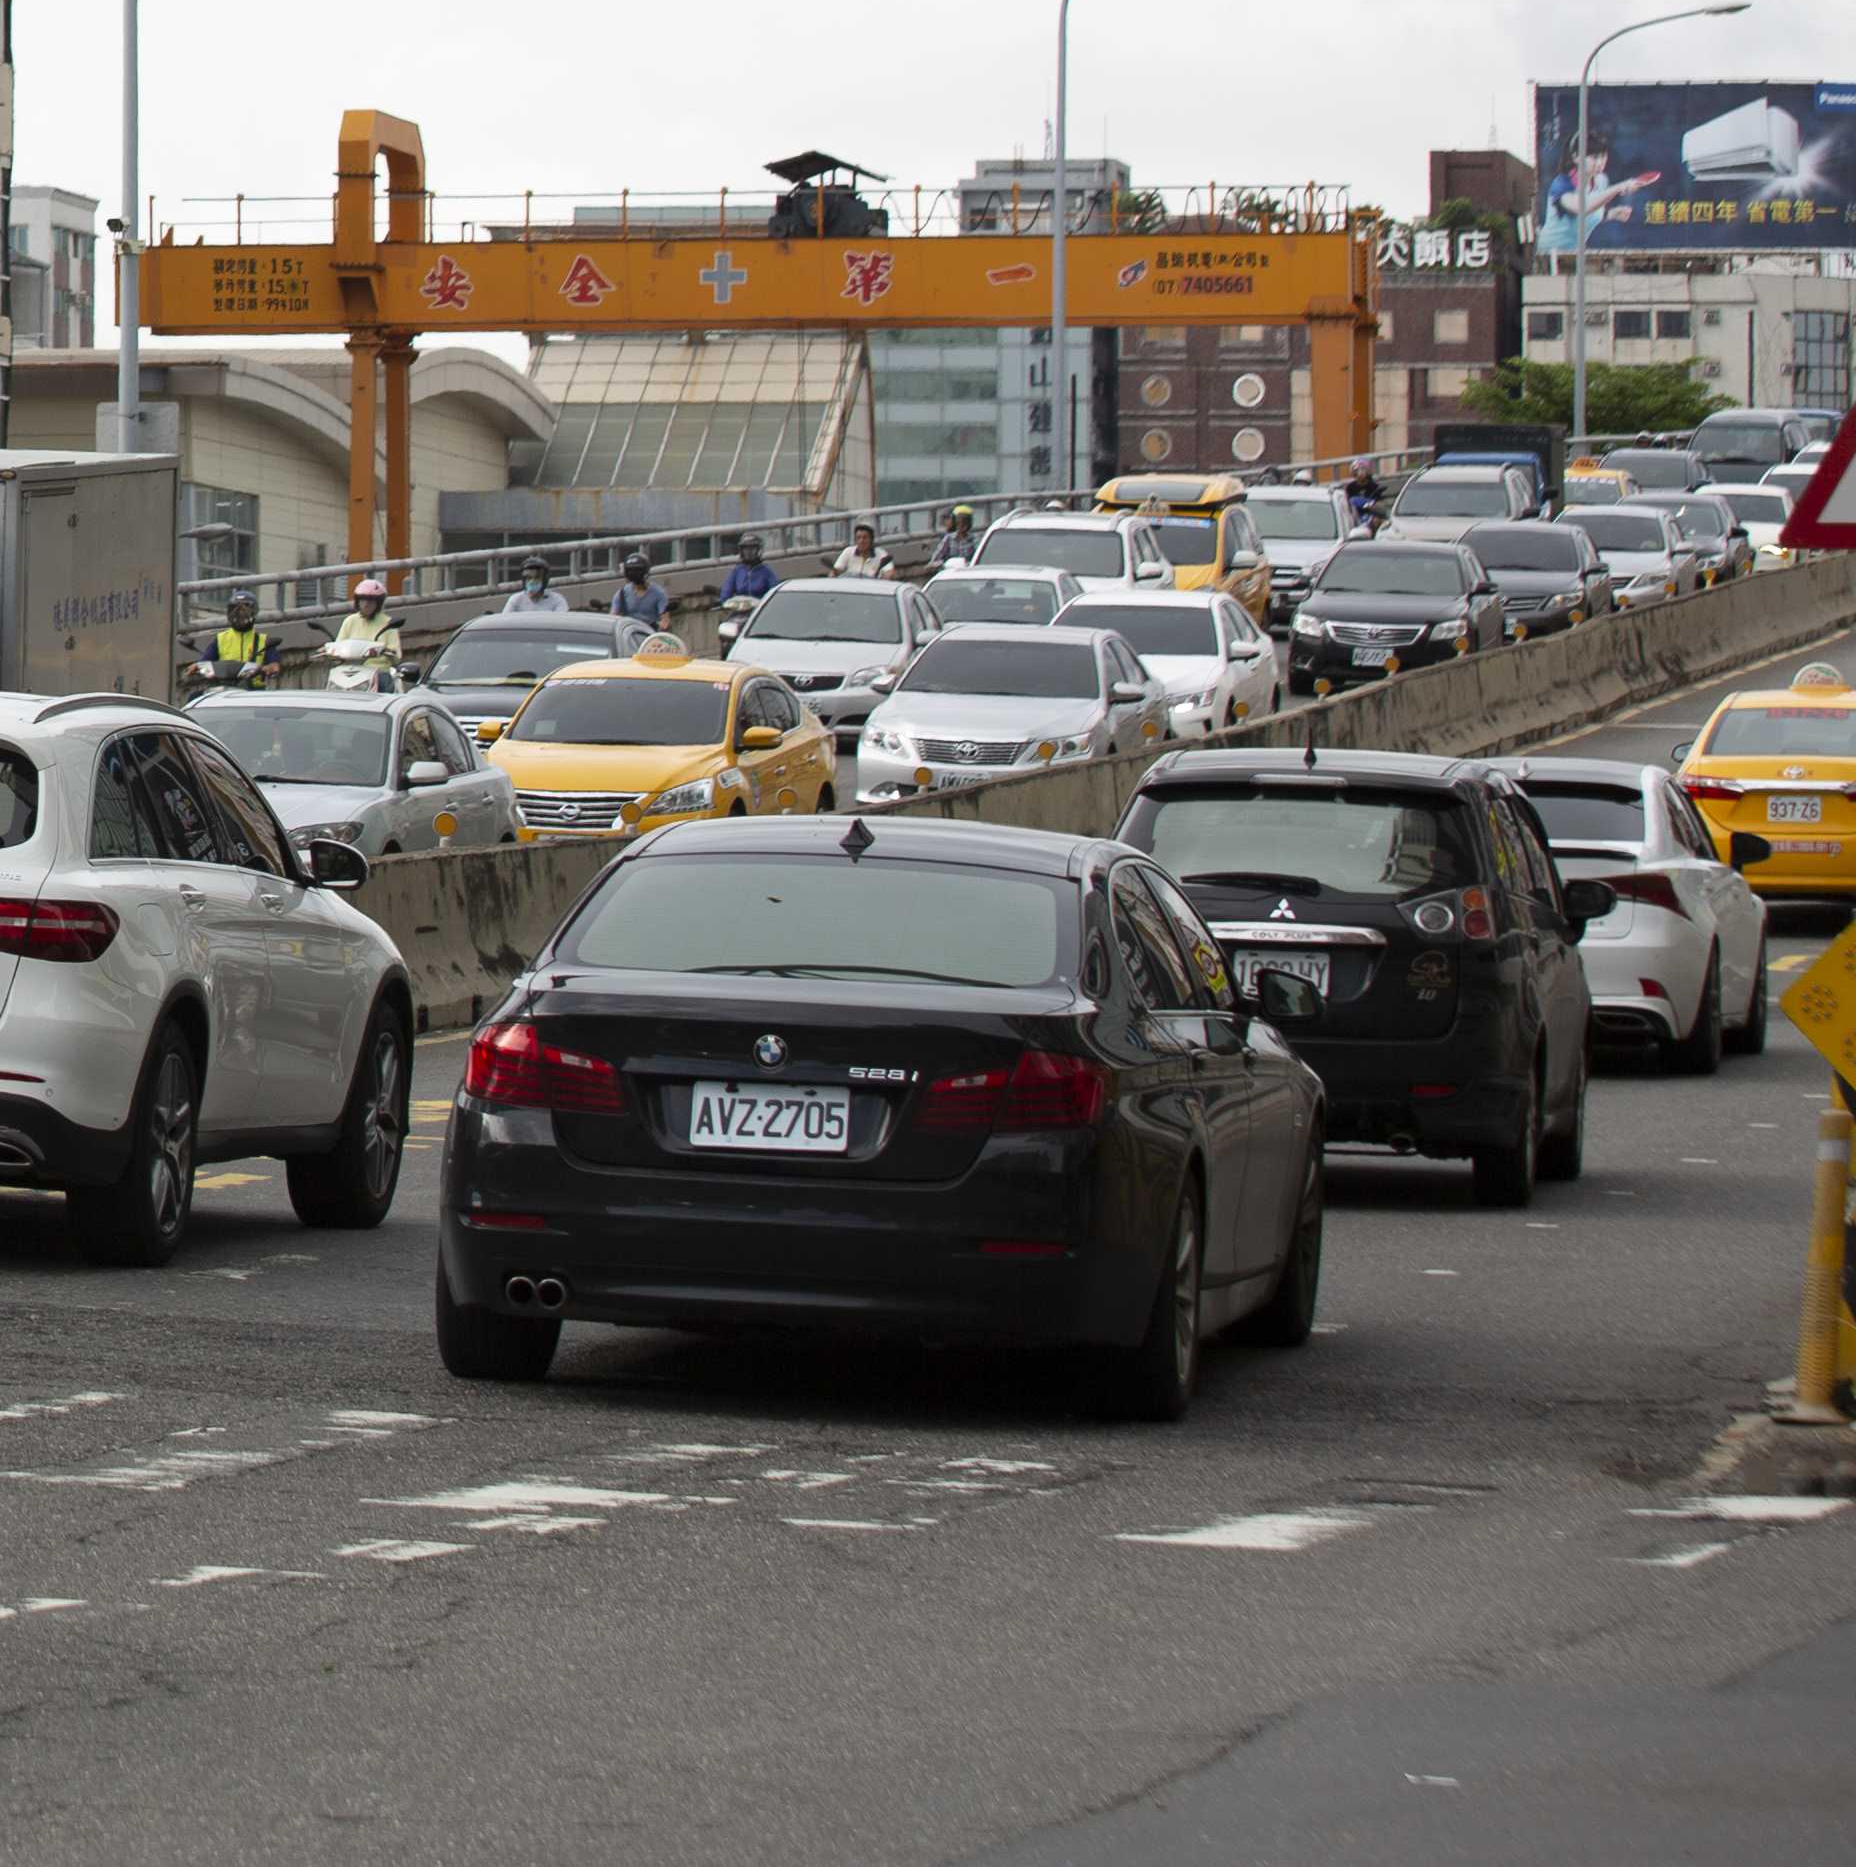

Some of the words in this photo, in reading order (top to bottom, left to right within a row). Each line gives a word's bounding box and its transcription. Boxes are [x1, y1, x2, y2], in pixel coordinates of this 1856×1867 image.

[1644, 199, 1738, 224] 連續四年
[1748, 199, 1838, 224] 省電第一
[1184, 276, 1253, 294] 7405661
